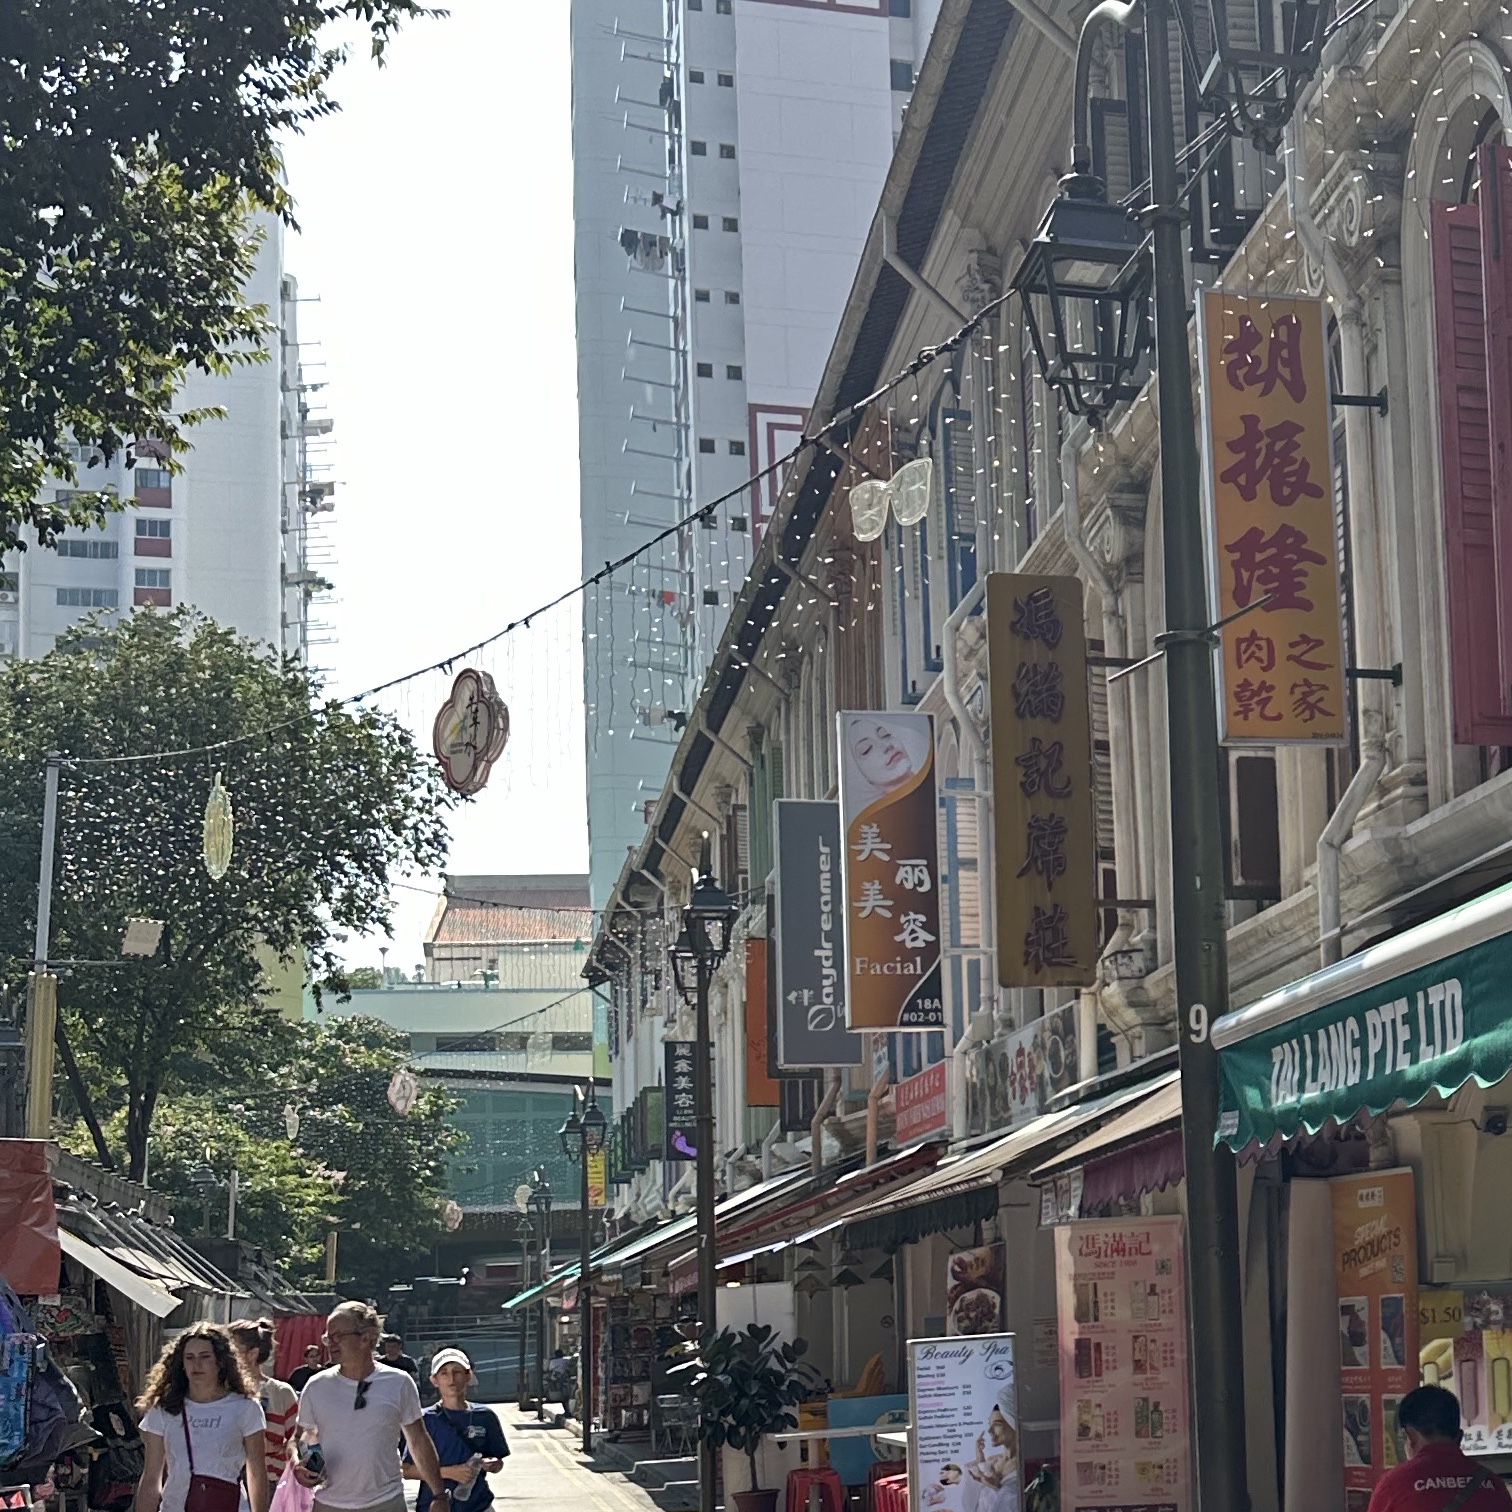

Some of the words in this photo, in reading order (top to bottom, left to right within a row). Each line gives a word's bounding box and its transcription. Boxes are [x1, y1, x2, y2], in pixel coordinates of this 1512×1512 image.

[1219, 313, 1328, 613] 胡振隆
[854, 957, 924, 976] Facial
[916, 998, 942, 1010] 18A
[1189, 1003, 1208, 1043] 9
[1269, 1037, 1300, 1108] TAI
[1303, 1013, 1361, 1095] LANG
[1365, 995, 1411, 1081] PTE
[1417, 977, 1465, 1064] LTD
[1342, 1226, 1401, 1272] PRODUCTS
[1420, 1305, 1463, 1325] $1.50
[917, 1344, 974, 1365] Beauty
[979, 1340, 1010, 1362] Spa
[1414, 1476, 1496, 1491] CANBEA
